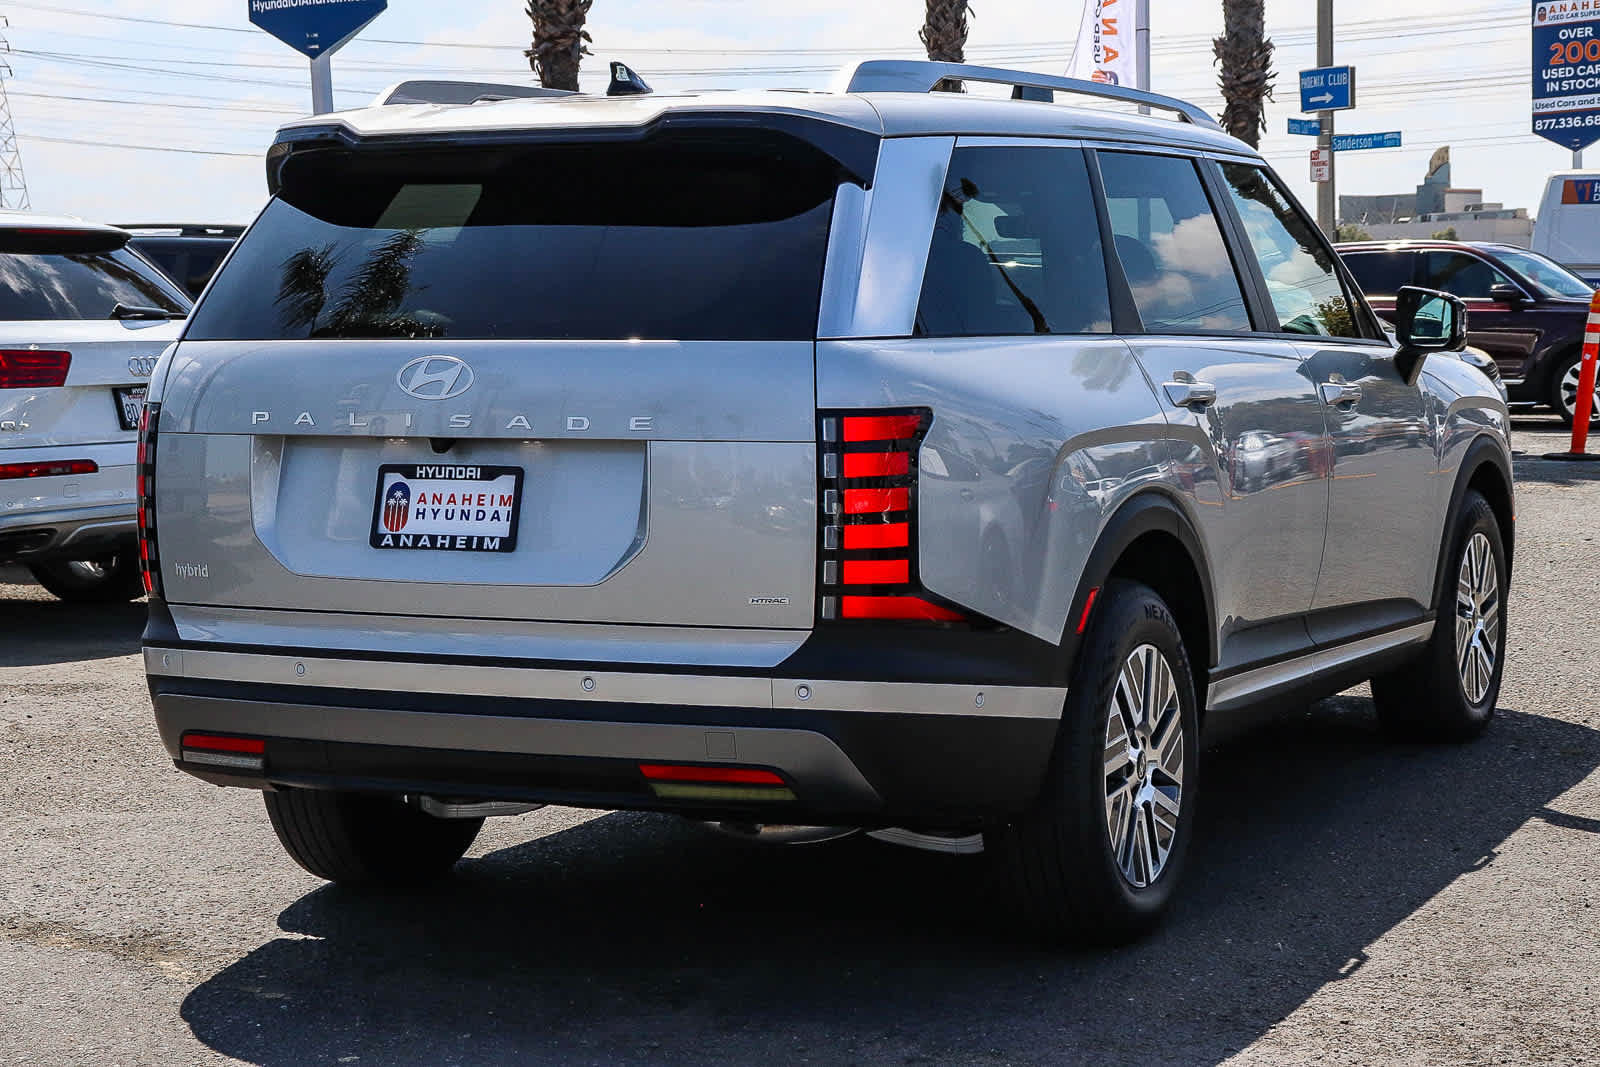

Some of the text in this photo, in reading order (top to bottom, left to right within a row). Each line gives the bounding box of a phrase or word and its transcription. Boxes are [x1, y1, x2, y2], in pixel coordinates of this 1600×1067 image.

[1559, 27, 1593, 40] OVER
[1328, 72, 1347, 86] CLUB
[1542, 67, 1574, 79] USED
[1546, 81, 1559, 92] IN
[1535, 101, 1555, 109] Used
[1556, 99, 1576, 107] Cars
[1577, 97, 1595, 106] and
[1332, 137, 1372, 151] Sanderson
[252, 401, 653, 431] PALISADE
[416, 465, 481, 480] HYUNDAI
[417, 492, 513, 507] ANAHEIM
[415, 508, 511, 522] HYUNDAI
[380, 534, 500, 550] ANAHEIM
[175, 562, 209, 580] hybrid
